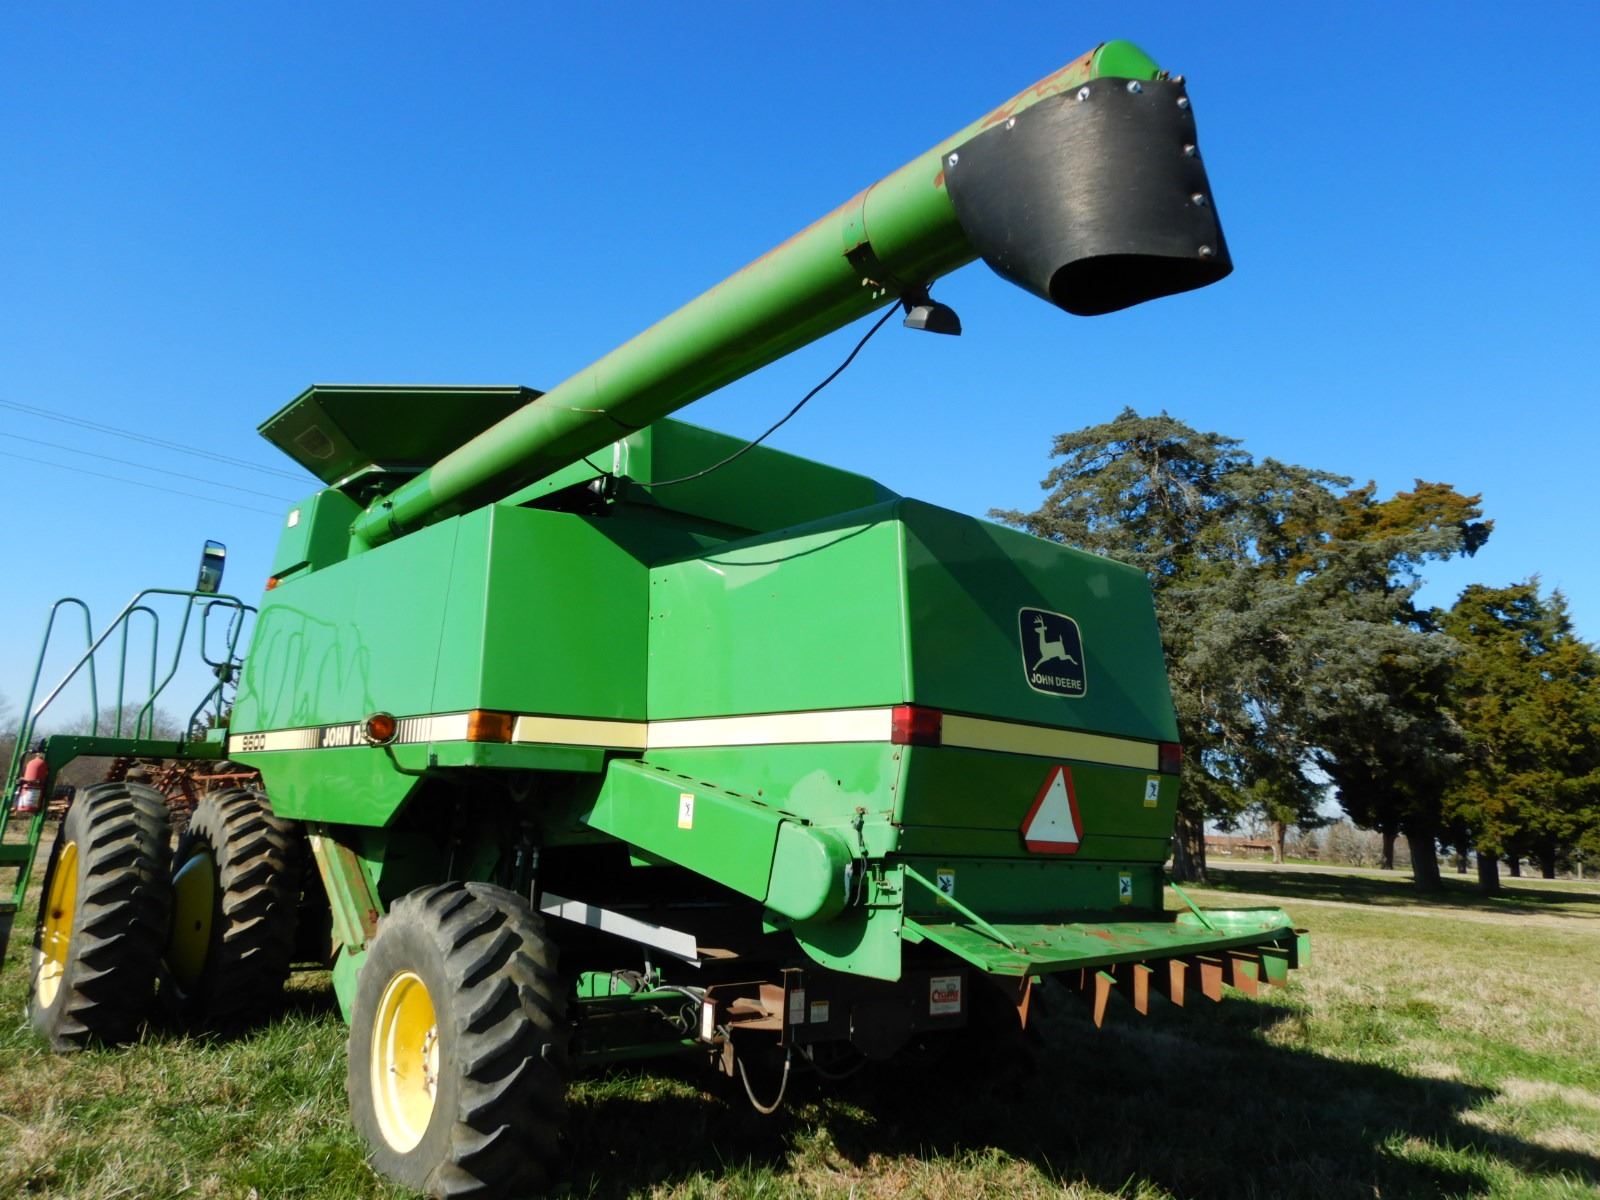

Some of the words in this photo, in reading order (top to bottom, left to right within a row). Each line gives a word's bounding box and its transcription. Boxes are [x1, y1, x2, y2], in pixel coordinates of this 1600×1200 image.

[1031, 673, 1054, 686] JOHN
[1055, 677, 1082, 690] DEERE
[242, 734, 266, 751] 9600
[323, 725, 352, 747] JOHN
